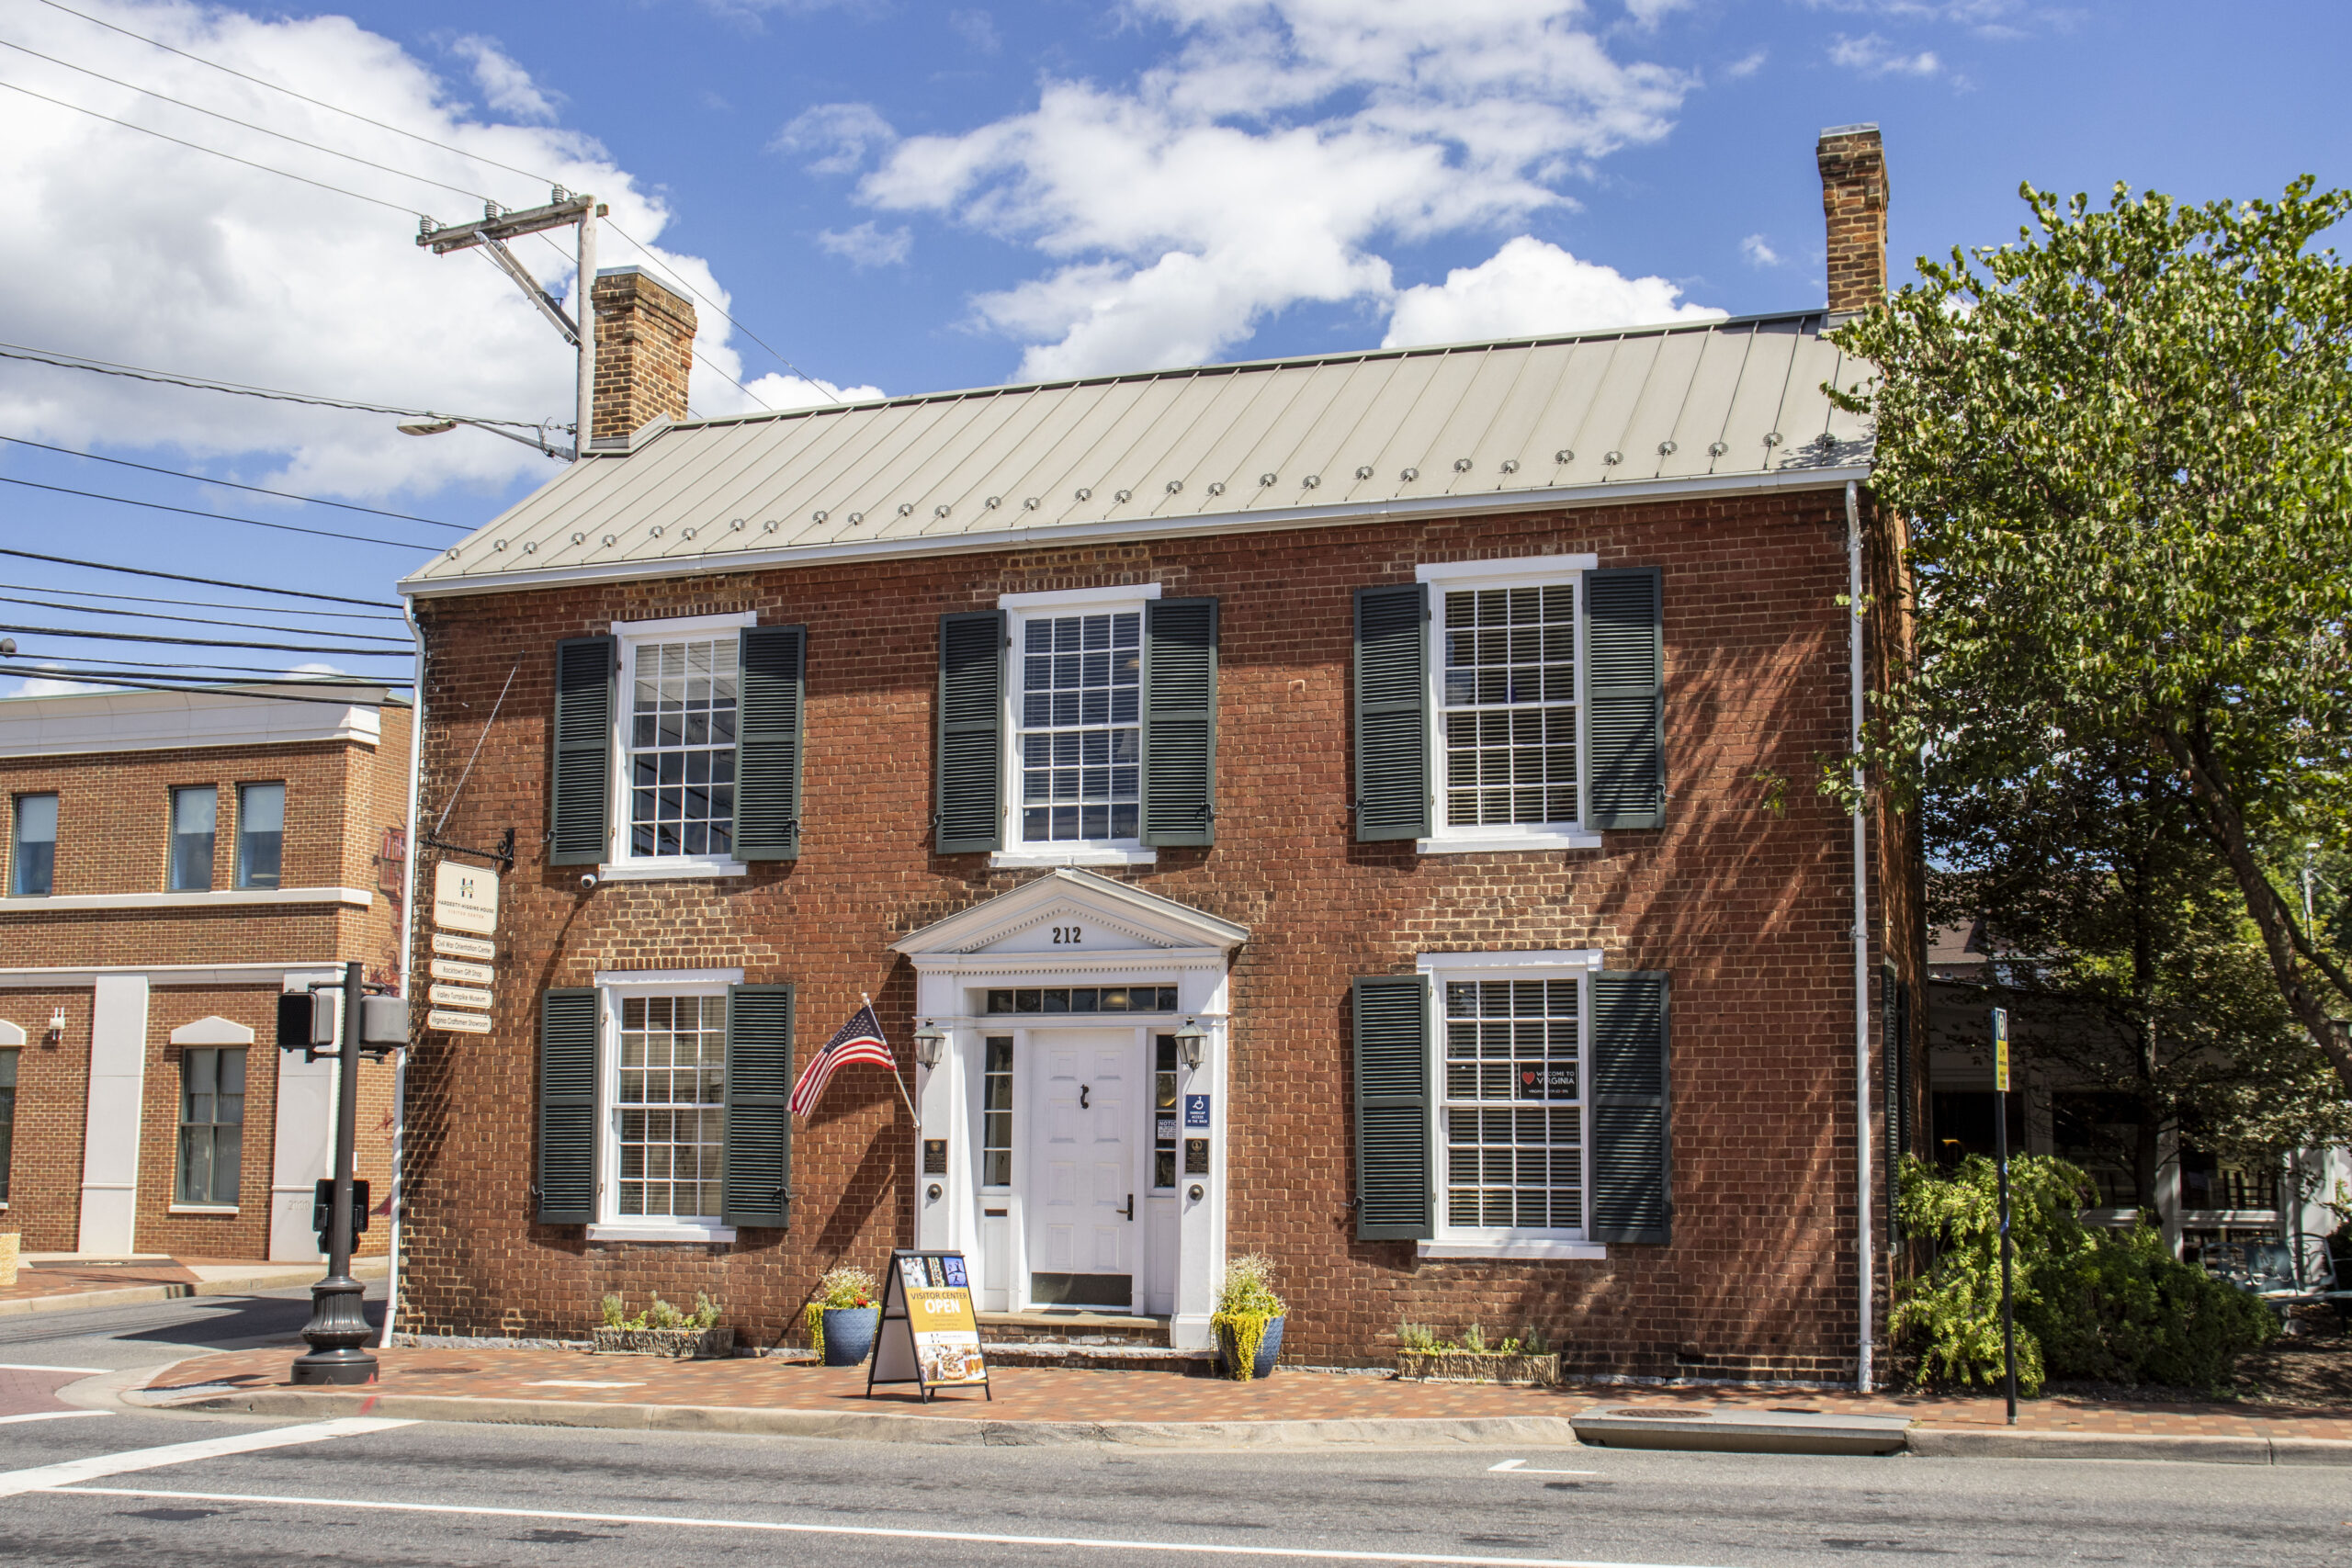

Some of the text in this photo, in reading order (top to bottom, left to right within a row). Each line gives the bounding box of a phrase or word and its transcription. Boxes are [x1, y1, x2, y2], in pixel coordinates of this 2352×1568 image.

[1052, 926, 1081, 944] 212
[435, 940, 446, 948] Civil
[455, 942, 478, 952] Orientation
[478, 945, 492, 953] Center
[443, 965, 463, 975] Rocktown
[471, 969, 482, 978] Shop
[436, 990, 450, 999] Valley
[451, 992, 469, 1001] Turnpike
[431, 1016, 447, 1026] Virginia
[469, 1020, 488, 1028] Showroom
[1536, 1077, 1575, 1085] VRGINIA
[910, 1292, 967, 1300] VISITOR CENTER
[924, 1299, 961, 1314] OPEN
